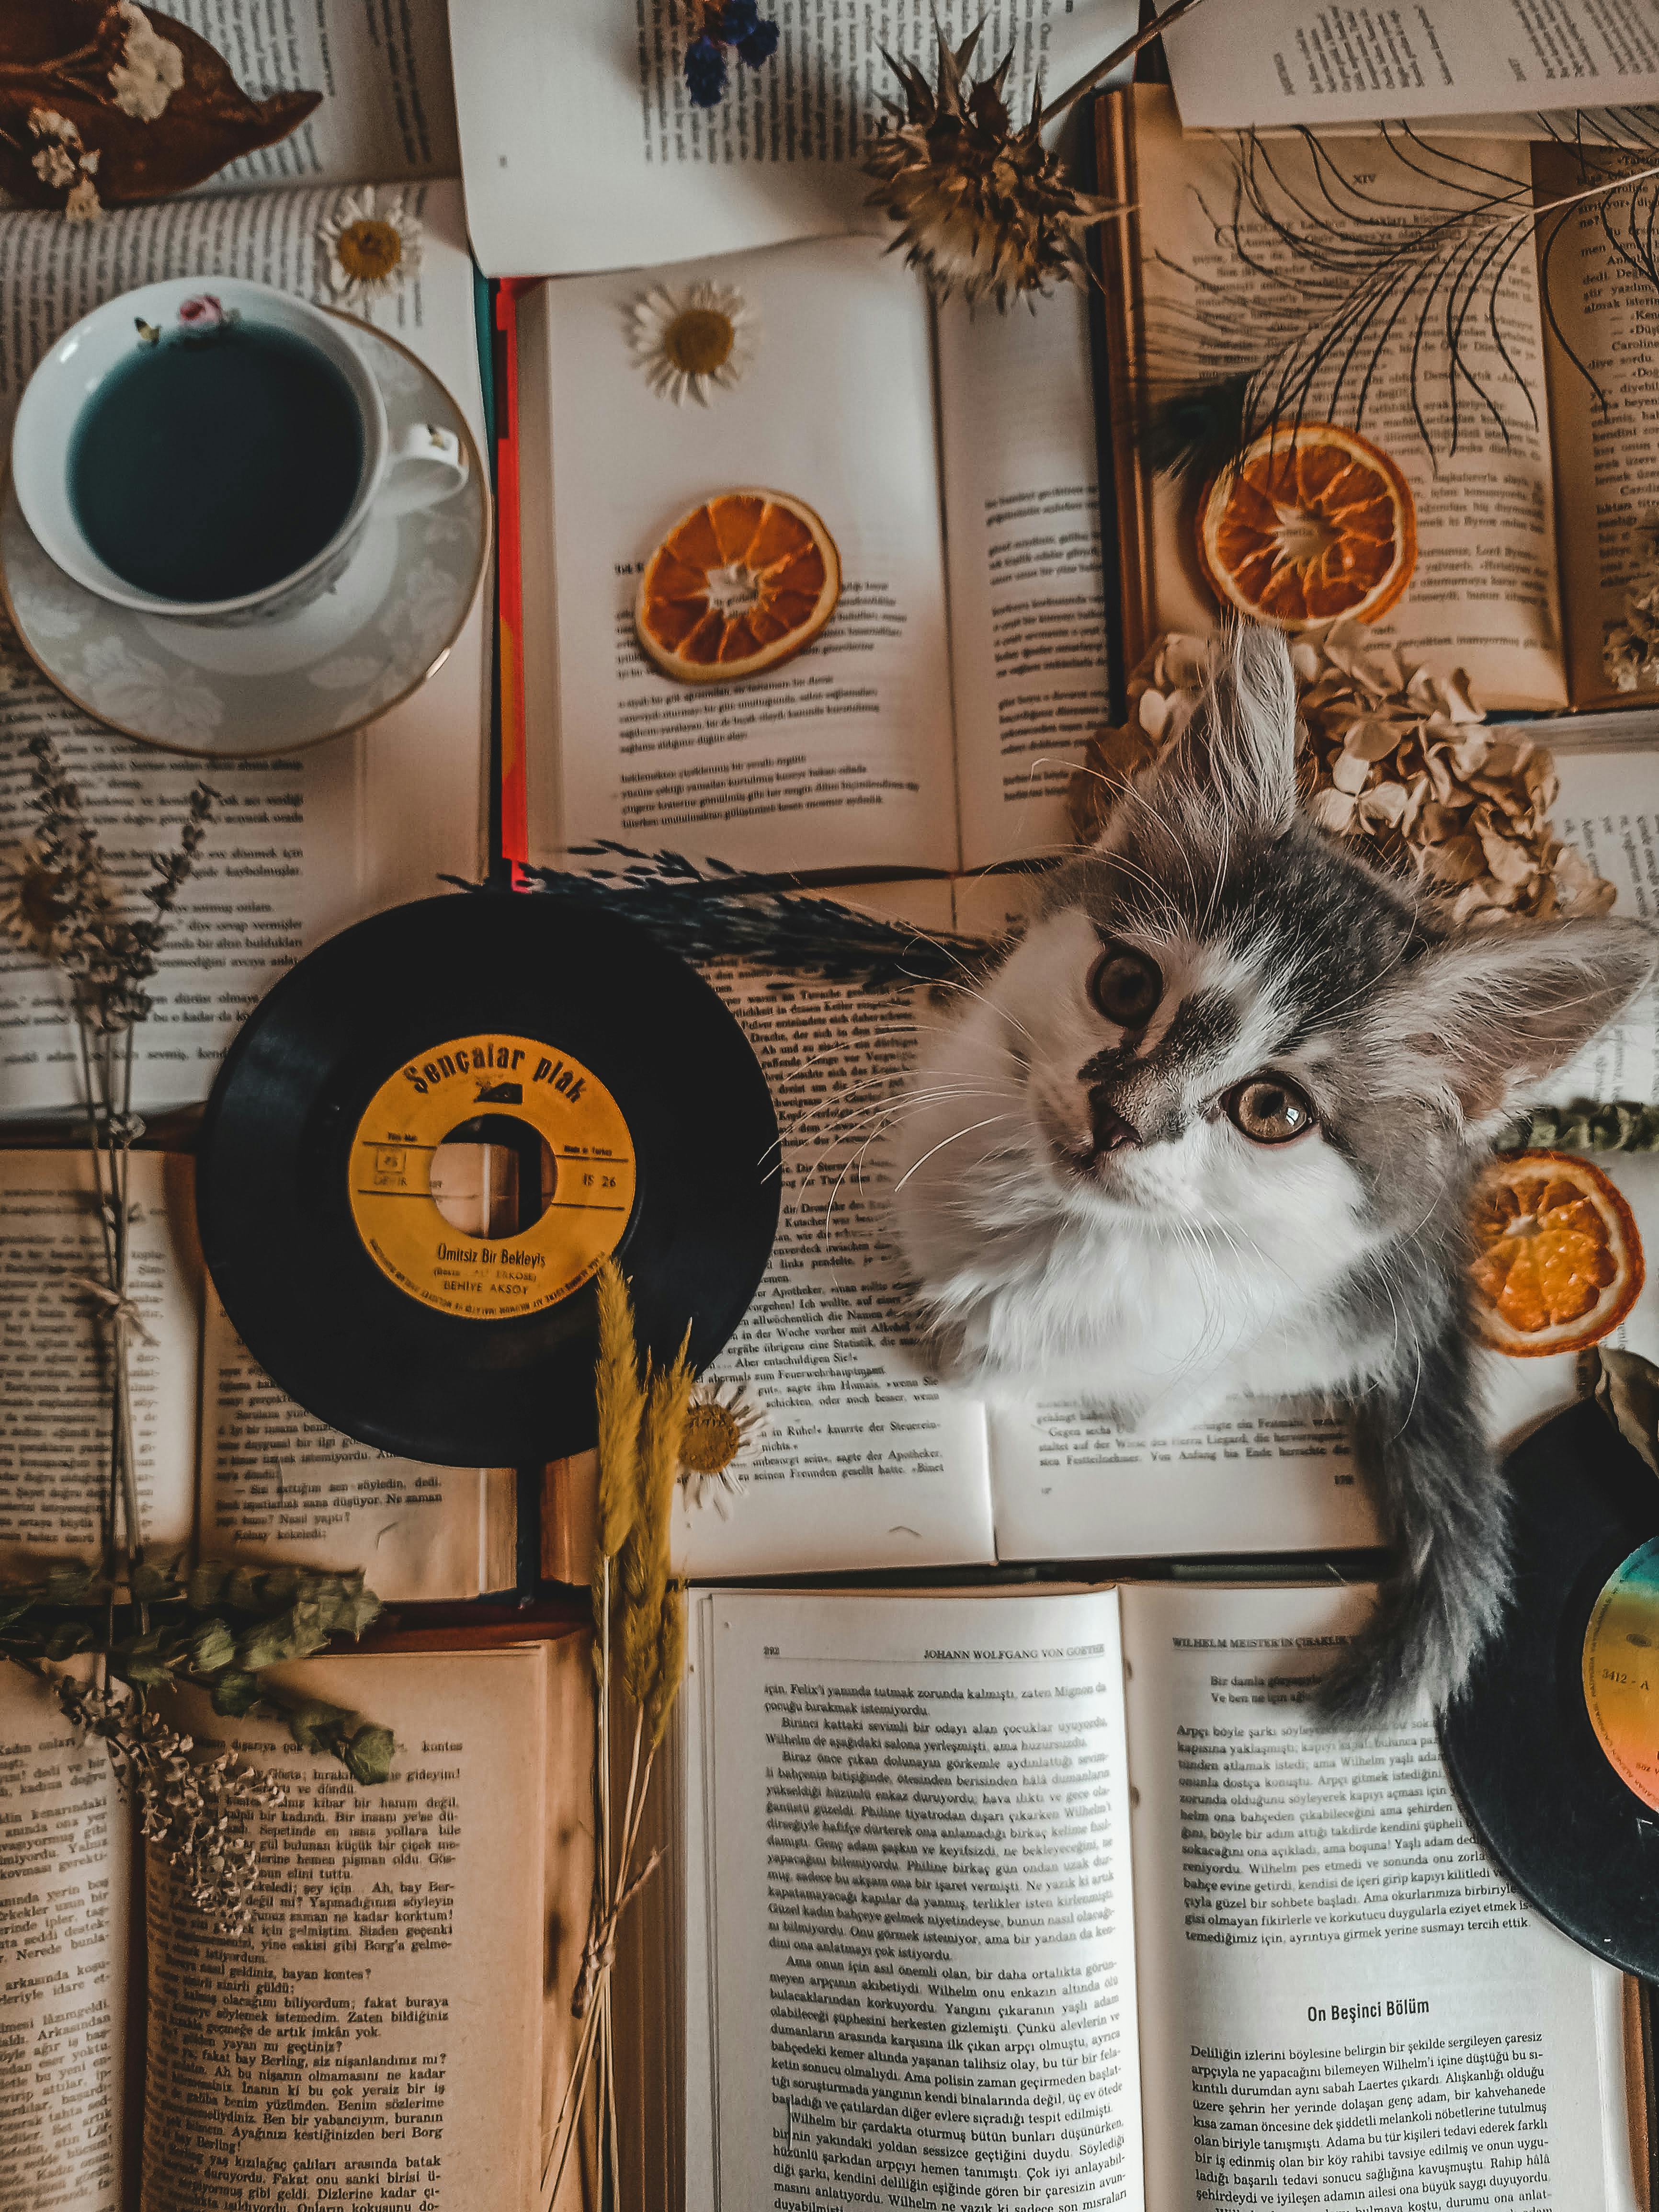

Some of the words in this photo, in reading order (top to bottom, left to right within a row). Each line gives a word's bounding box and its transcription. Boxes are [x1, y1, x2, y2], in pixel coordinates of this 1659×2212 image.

[1352, 173, 1376, 184] XIV
[533, 1057, 586, 1103] plak
[602, 1175, 616, 1188] 26
[482, 1248, 497, 1264] Bir
[924, 1649, 970, 1659] JOHANN
[973, 1649, 1038, 1659] WOLFGANG
[1041, 1648, 1064, 1657] VON
[1343, 1927, 1381, 1942] girmek
[1385, 1925, 1418, 1939] yerine
[1421, 1923, 1464, 1935] susmayı
[1467, 1918, 1500, 1931] tercih
[1308, 2006, 1326, 2022] On
[1331, 2001, 1382, 2023] Beşinci
[1387, 1998, 1429, 2016] Bölüm
[1191, 2044, 1242, 2062] Deliliğin
[1245, 2050, 1285, 2062] izlerini
[1344, 2044, 1386, 2057] belirgin
[1389, 2042, 1404, 2053] bir
[1408, 2038, 1445, 2054] şekilde
[1448, 2035, 1502, 2049] sergileyen
[1505, 2031, 1542, 2046] çaresiz
[1191, 2064, 1239, 2080] arpçıyla
[1259, 2067, 1321, 2081] yapacağını
[1324, 2064, 1380, 2076] bilemeyen
[1383, 2056, 1434, 2071] Wilhelm'i
[1437, 2055, 1463, 2069] içine
[1466, 2051, 1510, 2065] düştüğü
[1529, 2052, 1543, 2060] sı-
[904, 2071, 931, 2084] Ama
[934, 2074, 974, 2089] polisin
[977, 2079, 1016, 2088] zaman
[1020, 2074, 1086, 2090] geçirmeden
[1192, 2080, 1228, 2098] kıntılı
[1231, 2084, 1292, 2097] durumdan
[1295, 2087, 1319, 2098] aynı
[1322, 2081, 1355, 2094] sabah
[1358, 2079, 1398, 2091] Laertes
[1445, 2069, 1504, 2085] Alışkanlığı
[1507, 2066, 1545, 2080] olduğu
[872, 2087, 922, 2102] yangının
[924, 2090, 959, 2105] kendi
[958, 2093, 1030, 2108] binalarında
[1068, 2092, 1081, 2104] üç
[1083, 2090, 1095, 2100] ev
[1098, 2082, 1122, 2098] ötede
[1228, 2102, 1266, 2116] şehrin
[1271, 2103, 1288, 2114] her
[1295, 2101, 1337, 2116] yerinde
[1341, 2098, 1384, 2111] dolaşan
[1388, 2097, 1412, 2109] genç
[1418, 2092, 1450, 2104] adam,
[1454, 2089, 1470, 2100] bir
[1475, 2084, 1546, 2099] kahvehanede
[291, 2113, 309, 2128] bir
[412, 2126, 443, 2140] Borg
[793, 2111, 836, 2128] Wilhelm
[841, 2117, 857, 2133] bir
[862, 2121, 912, 2137] çardakta
[917, 2126, 966, 2143] oturmuş
[971, 2130, 1006, 2143] bütün
[1012, 2131, 1055, 2143] bunları
[771, 2161, 797, 2179] diği
[796, 2165, 832, 2183] şarkı,
[831, 2169, 879, 2190] kendini
[878, 2175, 931, 2194] deliliğin
[930, 2180, 981, 2197] eşiğinde
[985, 2186, 1019, 2199] gören
[1023, 2186, 1041, 2198] bir
[1045, 2181, 1095, 2199] çaresizin
